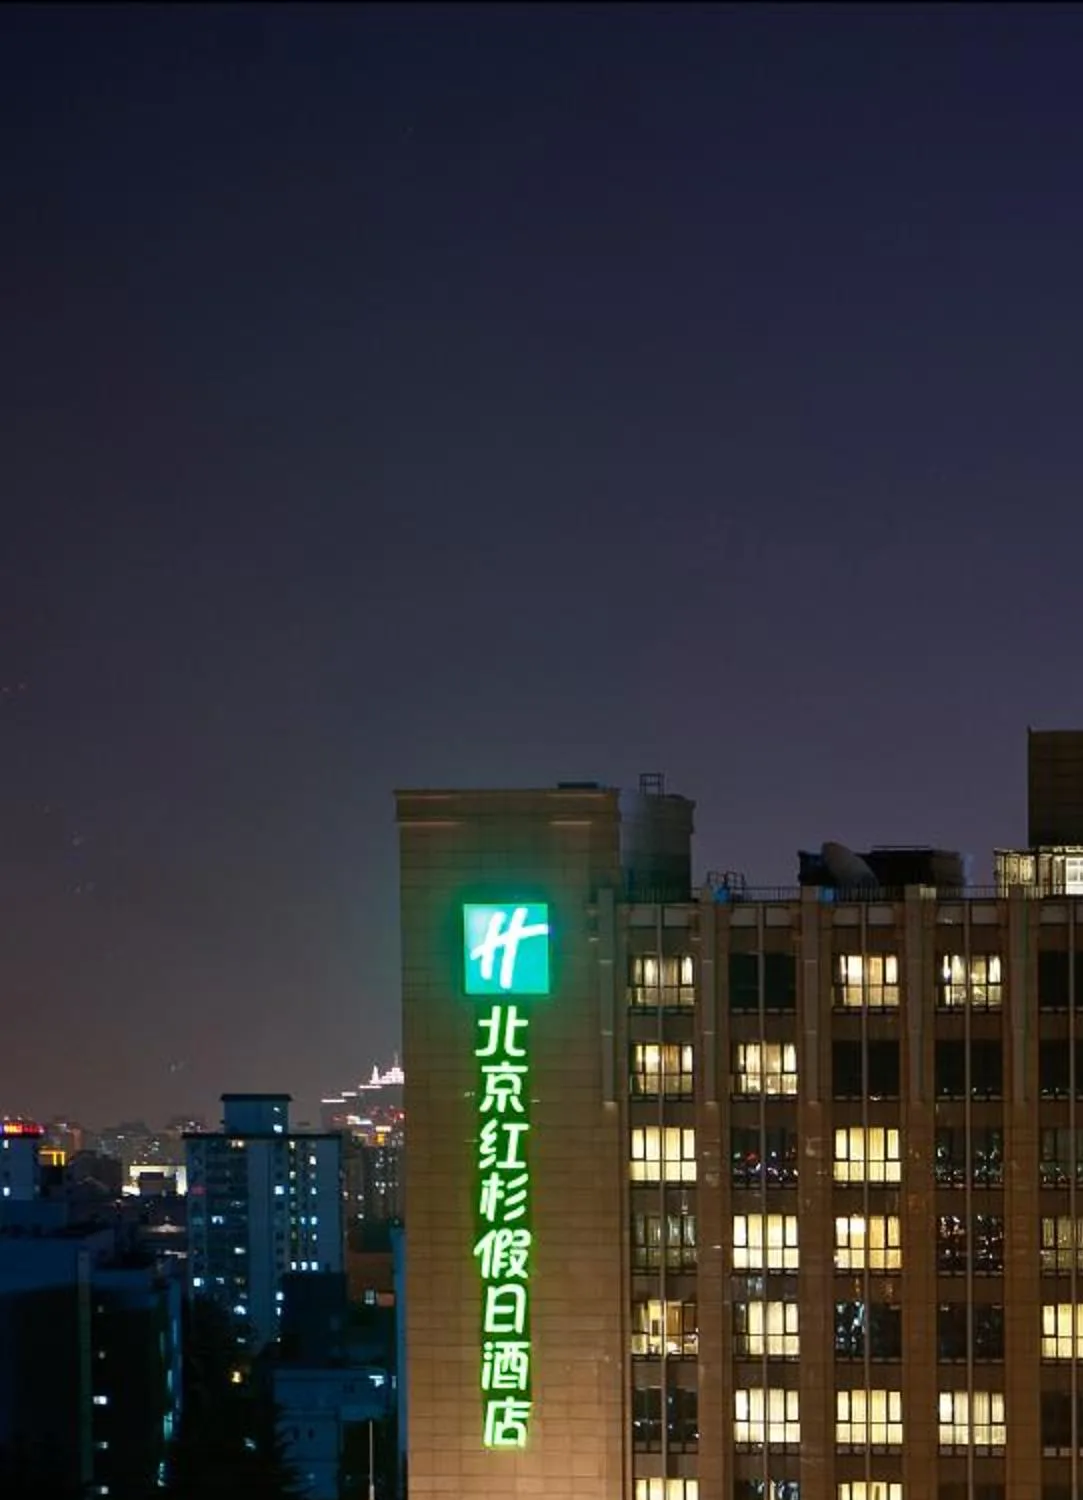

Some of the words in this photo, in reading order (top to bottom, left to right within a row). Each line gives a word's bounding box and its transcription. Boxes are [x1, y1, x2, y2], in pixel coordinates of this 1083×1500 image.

[473, 1005, 532, 1448] 北京红杉假日酒店
